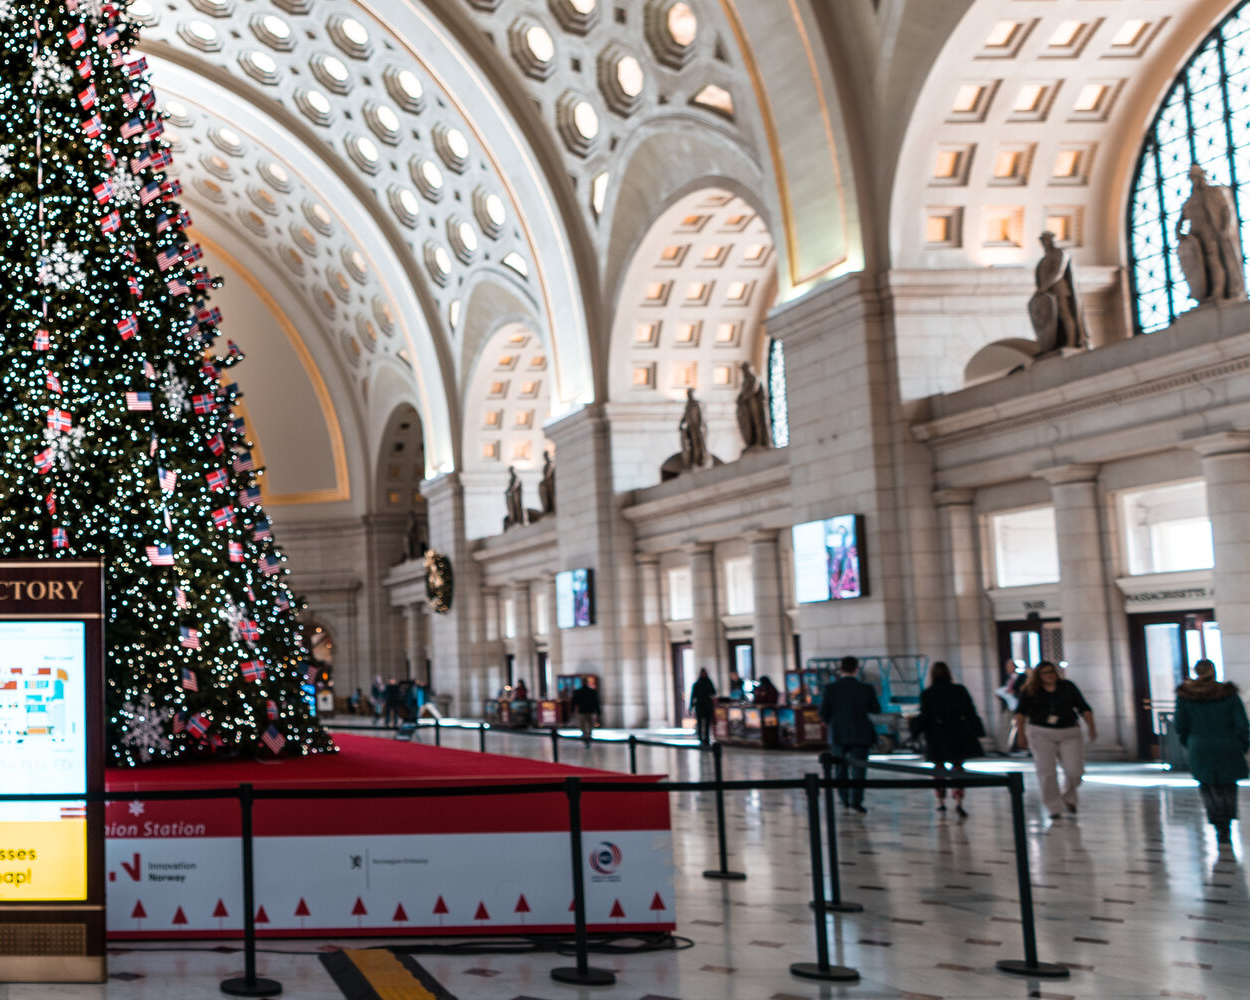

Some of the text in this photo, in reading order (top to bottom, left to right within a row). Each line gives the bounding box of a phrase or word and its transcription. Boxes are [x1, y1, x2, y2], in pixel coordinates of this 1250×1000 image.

[143, 820, 206, 837] Station
[148, 861, 197, 871] Innovation
[148, 873, 186, 884] Norway
